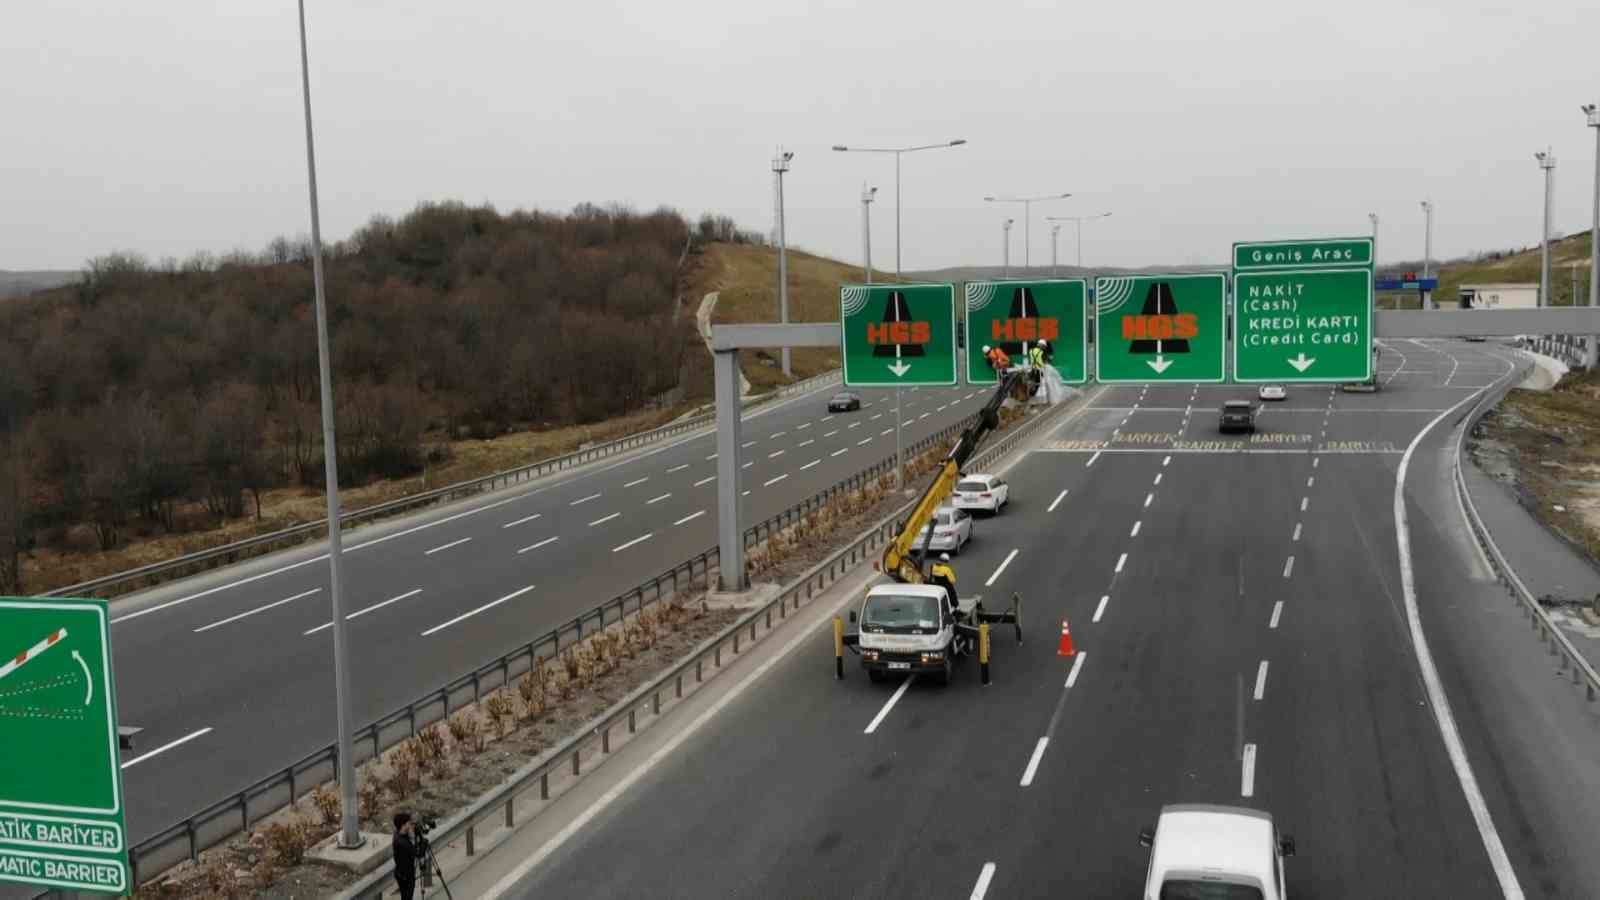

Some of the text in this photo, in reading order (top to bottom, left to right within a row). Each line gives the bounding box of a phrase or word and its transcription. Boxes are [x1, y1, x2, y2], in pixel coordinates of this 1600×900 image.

[1249, 282, 1305, 297] NAKİT
[1243, 299, 1297, 312] (Cash)
[867, 321, 931, 345] HGS
[991, 318, 1059, 341] HGS
[1121, 313, 1198, 339] HGS
[1249, 315, 1358, 330] KREDİ KARTI
[1311, 332, 1359, 345] Card)
[36, 823, 115, 848] BARİYER
[44, 861, 119, 884] BARRIER
